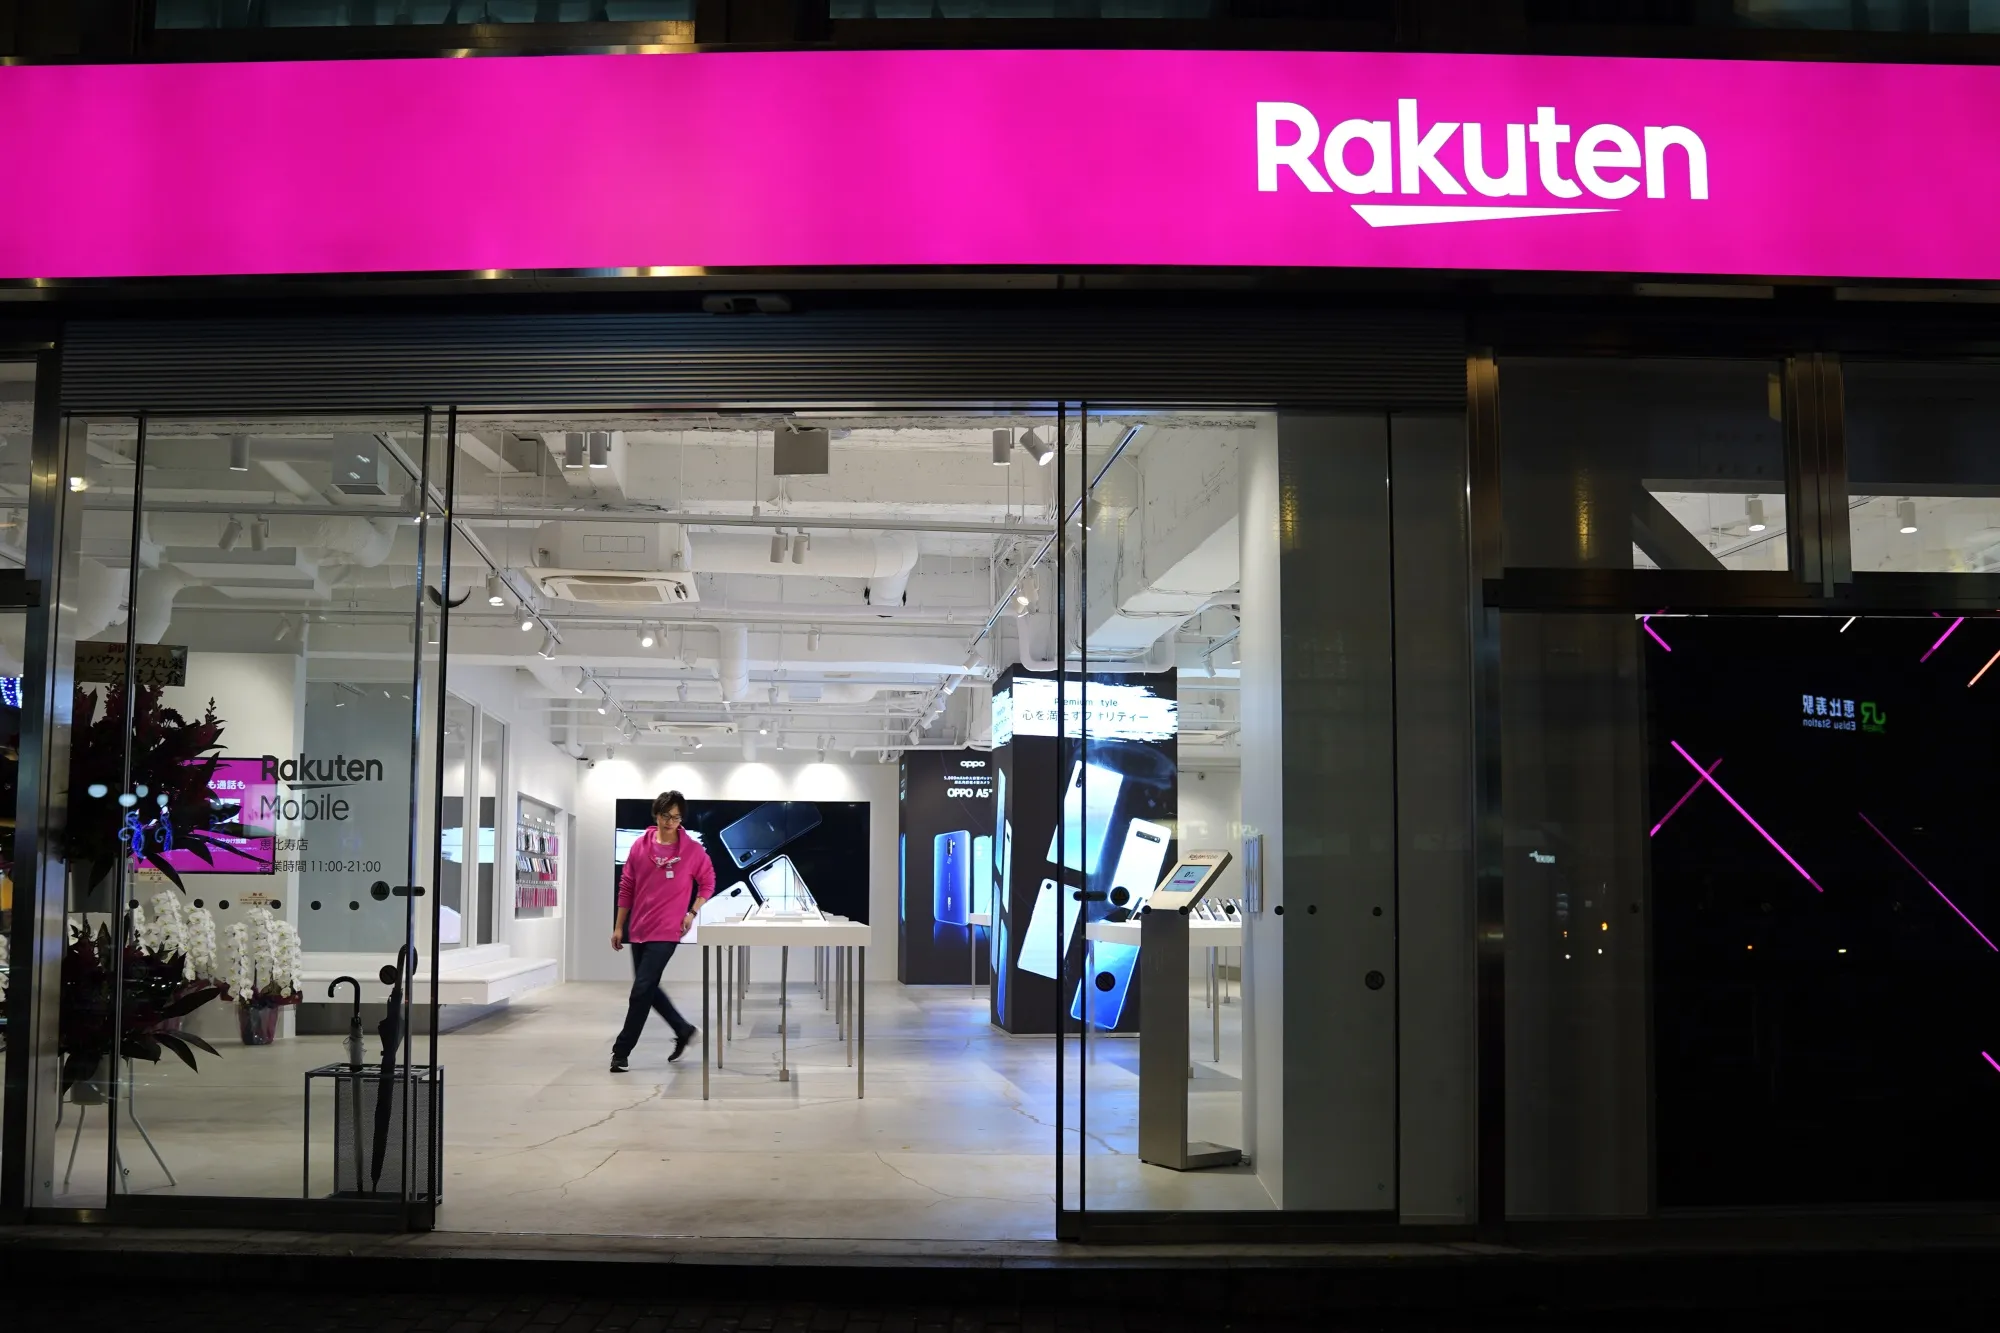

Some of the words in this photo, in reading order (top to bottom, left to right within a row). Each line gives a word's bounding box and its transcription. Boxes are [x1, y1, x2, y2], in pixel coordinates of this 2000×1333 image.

[1256, 98, 1709, 200] Rakuten
[261, 753, 383, 781] Rakuten
[947, 787, 974, 798] OPPO
[260, 793, 350, 821] Mobile
[260, 839, 309, 851] 恵比寿店
[259, 860, 307, 872] 営業時間
[311, 860, 382, 872] 11:00-21:00
